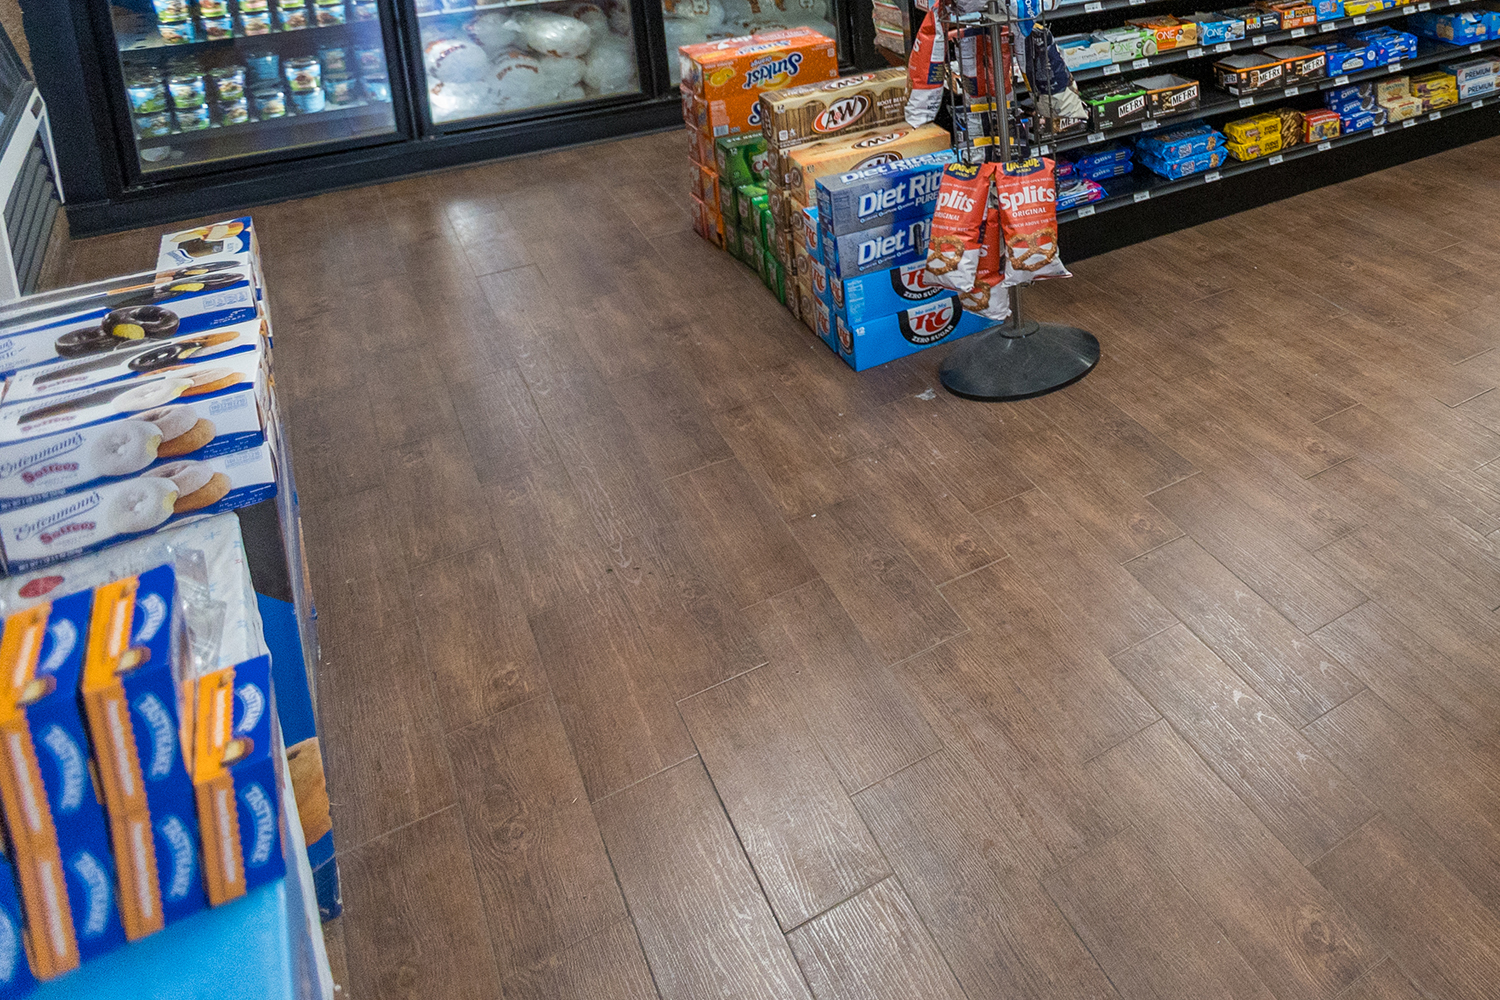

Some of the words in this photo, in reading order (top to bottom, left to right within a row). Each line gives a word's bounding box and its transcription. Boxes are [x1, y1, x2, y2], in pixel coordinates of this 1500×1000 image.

[1296, 7, 1316, 15] PROTEIN
[1156, 30, 1176, 41] ONE
[1206, 26, 1225, 39] ONE
[1246, 22, 1262, 31] KIND
[1114, 41, 1133, 53] ONE
[742, 52, 803, 89] Sunkist
[1464, 67, 1492, 80] PREMIUM
[1341, 88, 1359, 100] OREO
[1467, 81, 1494, 95] PREMIUM
[825, 95, 860, 130] A&W
[1343, 102, 1361, 113] OREO
[1356, 115, 1375, 128] OREO
[841, 164, 888, 184] Diet
[889, 153, 934, 173] Rite
[858, 183, 907, 219] Diet
[915, 193, 939, 207] PURE
[936, 189, 976, 213] plits
[999, 185, 1056, 211] Splits
[1012, 206, 1047, 218] ORIGINAL
[805, 227, 818, 249] RC
[857, 229, 907, 267] Diet
[812, 271, 827, 293] RC
[903, 268, 925, 288] R
[830, 281, 843, 302] RC
[904, 289, 923, 300] ZERO
[817, 313, 831, 335] RC
[909, 306, 952, 333] RC
[838, 328, 851, 349] RC
[855, 326, 866, 337] 12
[911, 332, 931, 343] ZERO
[931, 324, 955, 340] SUGAR
[14, 490, 103, 541] Entenmann's
